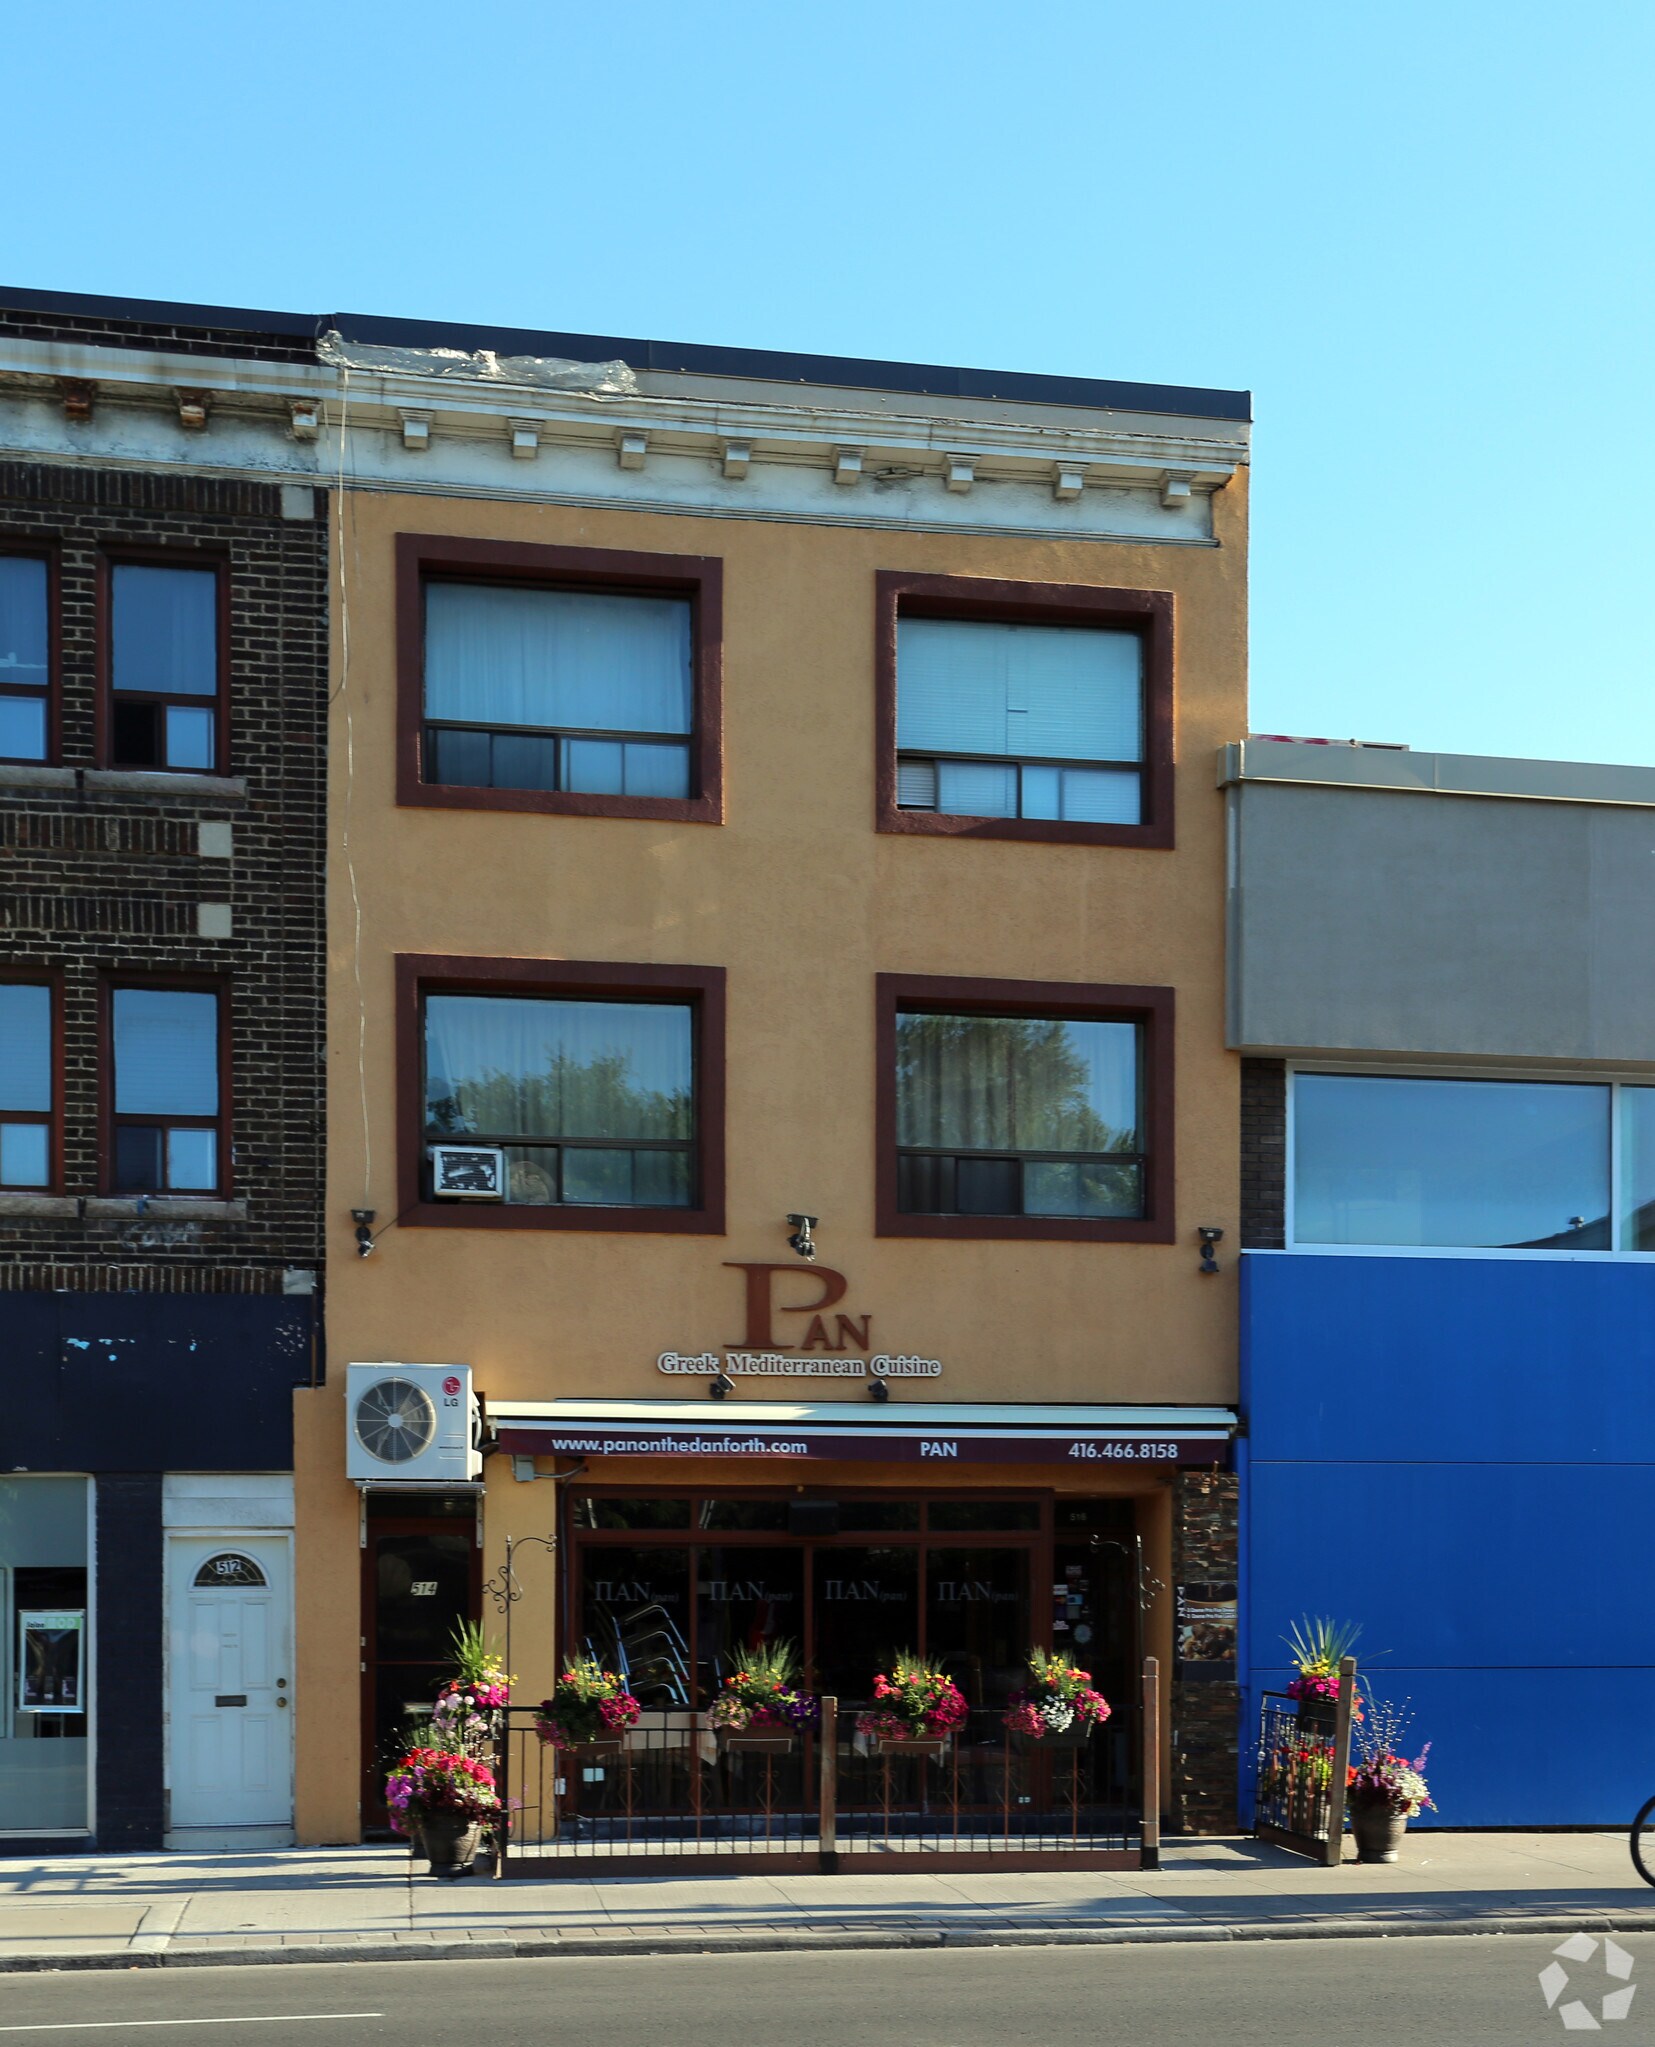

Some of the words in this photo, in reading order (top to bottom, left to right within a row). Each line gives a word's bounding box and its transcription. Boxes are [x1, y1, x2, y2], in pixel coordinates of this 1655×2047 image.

[659, 1353, 719, 1373] Greek
[726, 1355, 865, 1375] Mediterranean
[871, 1356, 941, 1375] Cuisine
[444, 1398, 459, 1407] LG
[552, 1437, 808, 1454] www.panonthedanforth.com
[920, 1442, 958, 1457] PAN
[1068, 1443, 1179, 1458] 416.466.8158
[217, 1561, 241, 1574] 512
[411, 1583, 436, 1595] 514
